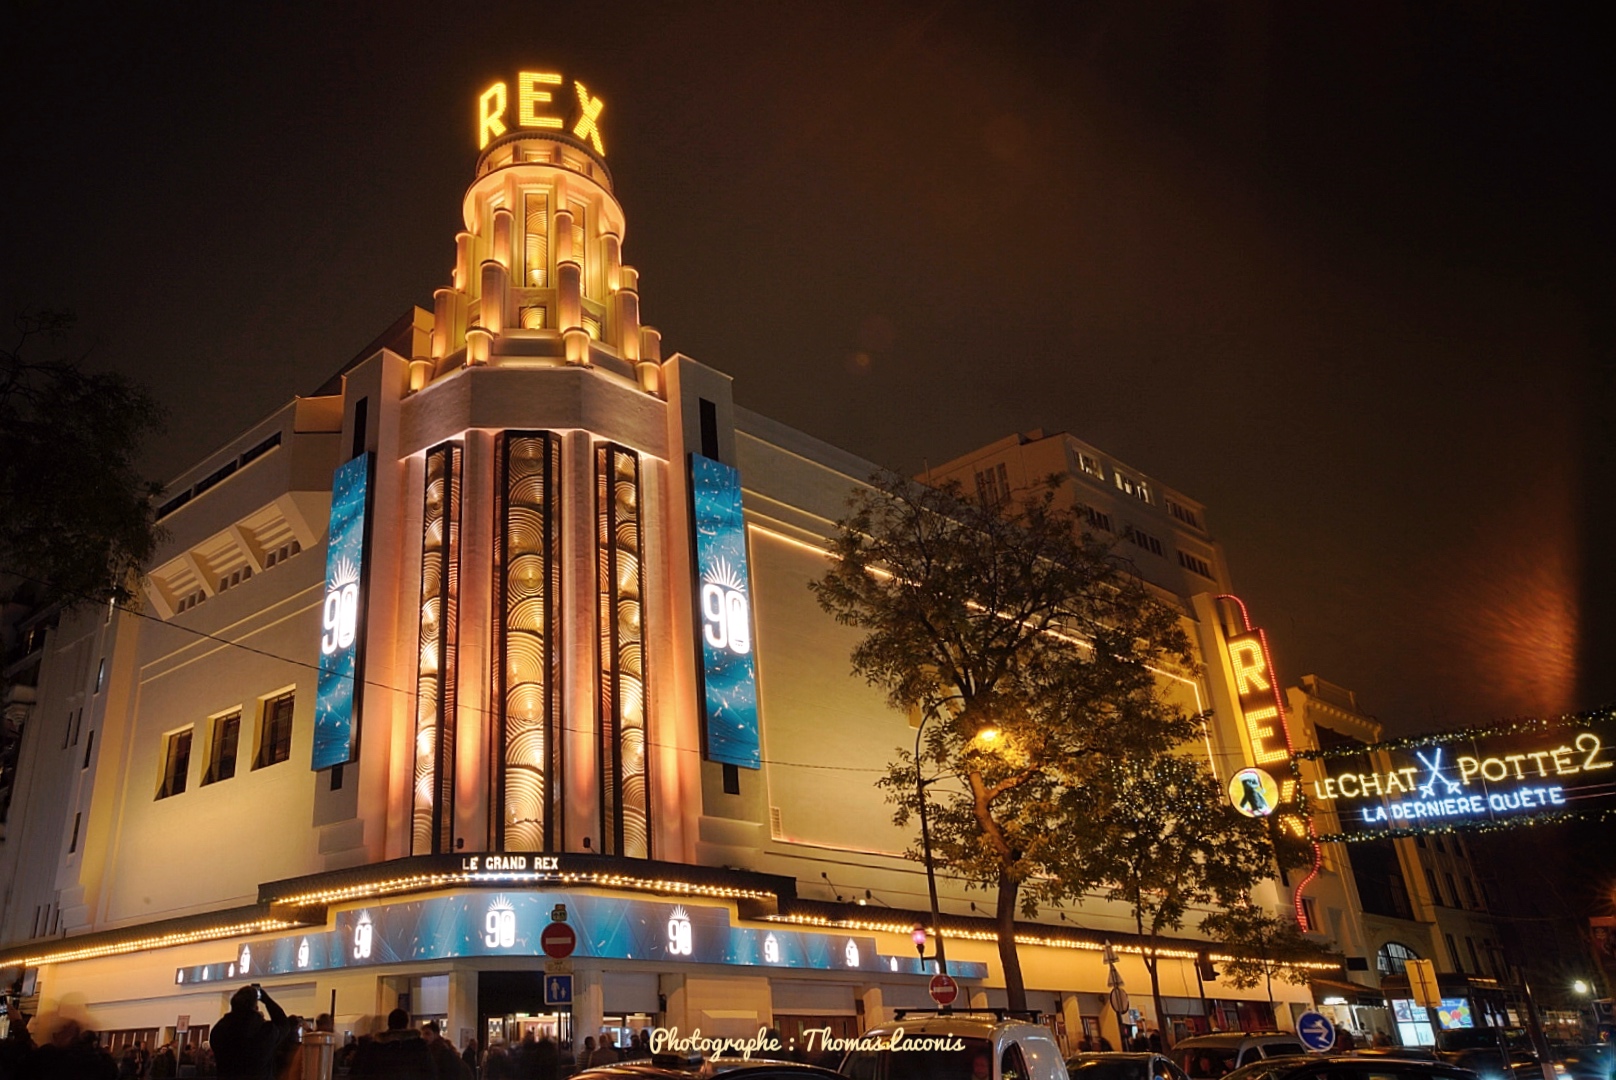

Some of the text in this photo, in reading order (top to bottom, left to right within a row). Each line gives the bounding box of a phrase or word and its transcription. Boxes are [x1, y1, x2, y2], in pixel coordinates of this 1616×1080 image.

[479, 71, 606, 157] REX
[322, 583, 358, 655] 90
[703, 583, 750, 654] 90
[1314, 778, 1339, 800] LE
[1338, 767, 1418, 798] CHAT
[1575, 732, 1614, 771] 2
[1362, 806, 1388, 823] LA
[462, 856, 559, 871] LE GRAND REX
[353, 924, 373, 960] 90
[485, 910, 516, 948] 90
[668, 919, 693, 956] 90
